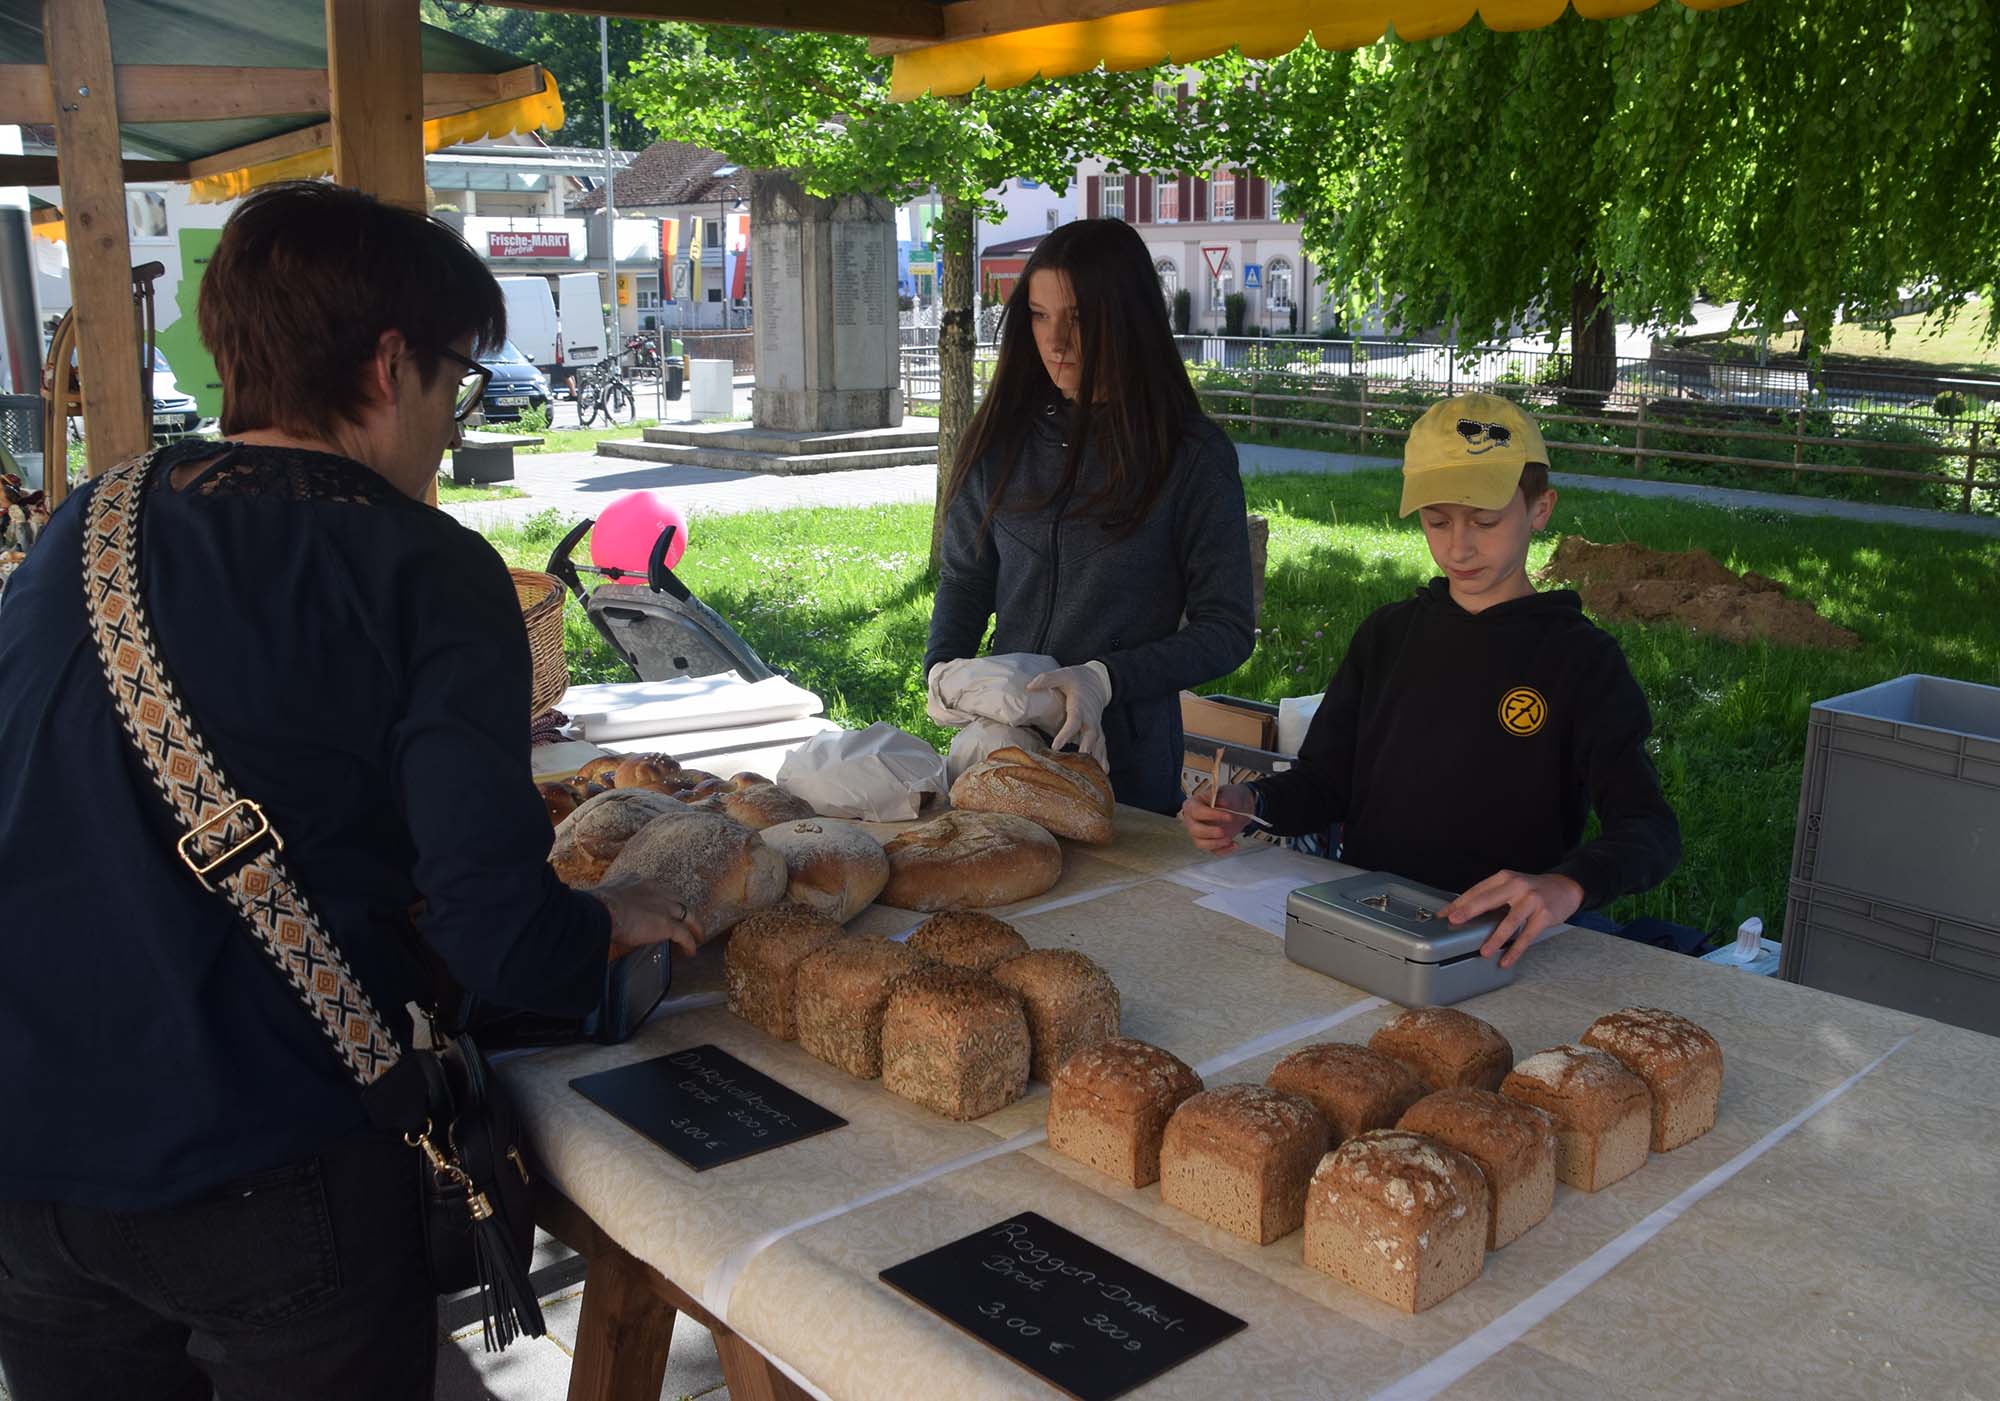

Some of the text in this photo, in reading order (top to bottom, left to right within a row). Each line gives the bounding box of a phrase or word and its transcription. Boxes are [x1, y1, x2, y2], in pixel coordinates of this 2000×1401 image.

[490, 233, 567, 247] Frische-MARKT
[982, 1255, 1048, 1292] Brot
[978, 1302, 1041, 1336] 3,00
